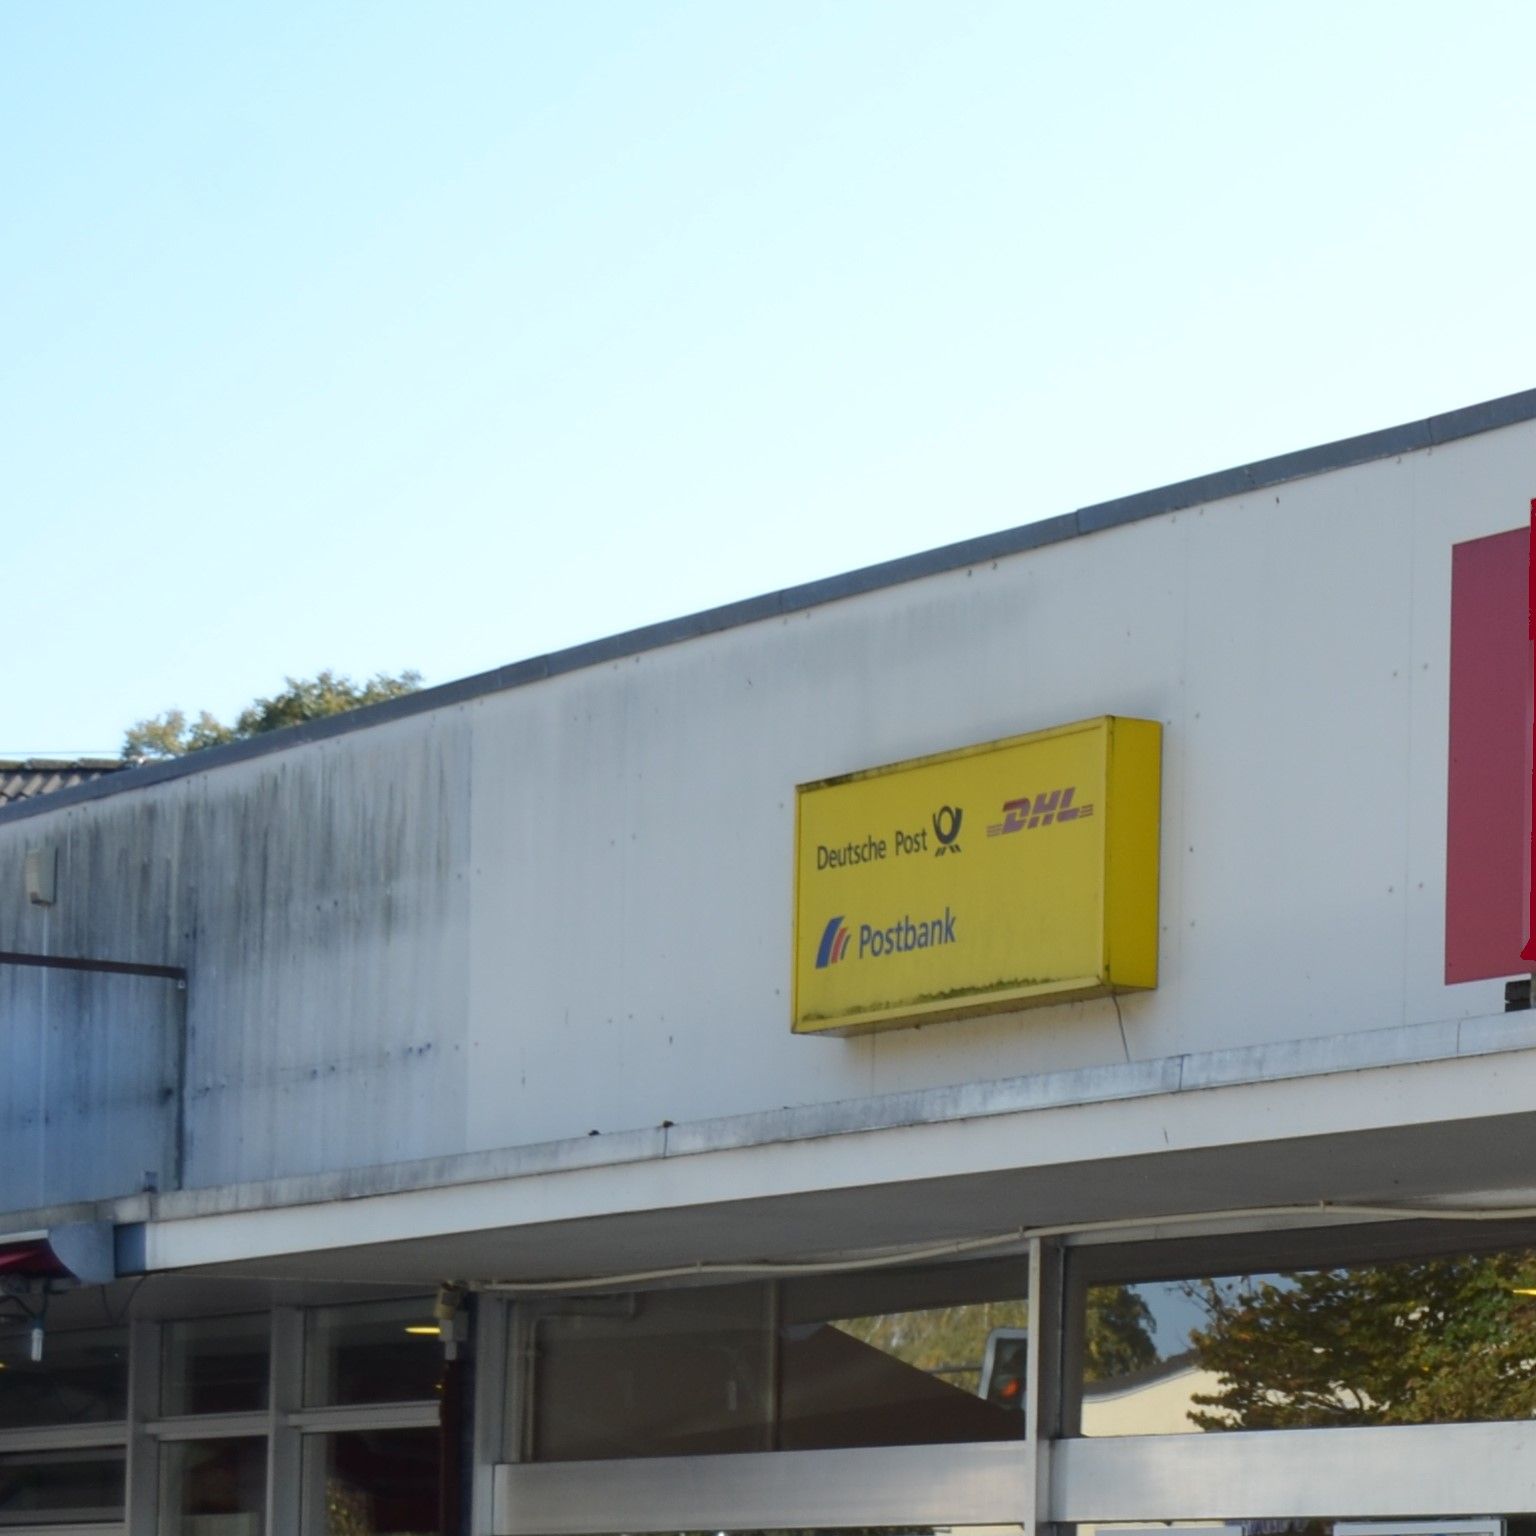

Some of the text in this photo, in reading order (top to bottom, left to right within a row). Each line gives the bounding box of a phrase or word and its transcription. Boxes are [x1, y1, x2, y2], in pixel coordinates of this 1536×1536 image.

[1000, 787, 1082, 835] DHL
[816, 828, 928, 870] Deutsche Post
[858, 906, 957, 960] Postbank
